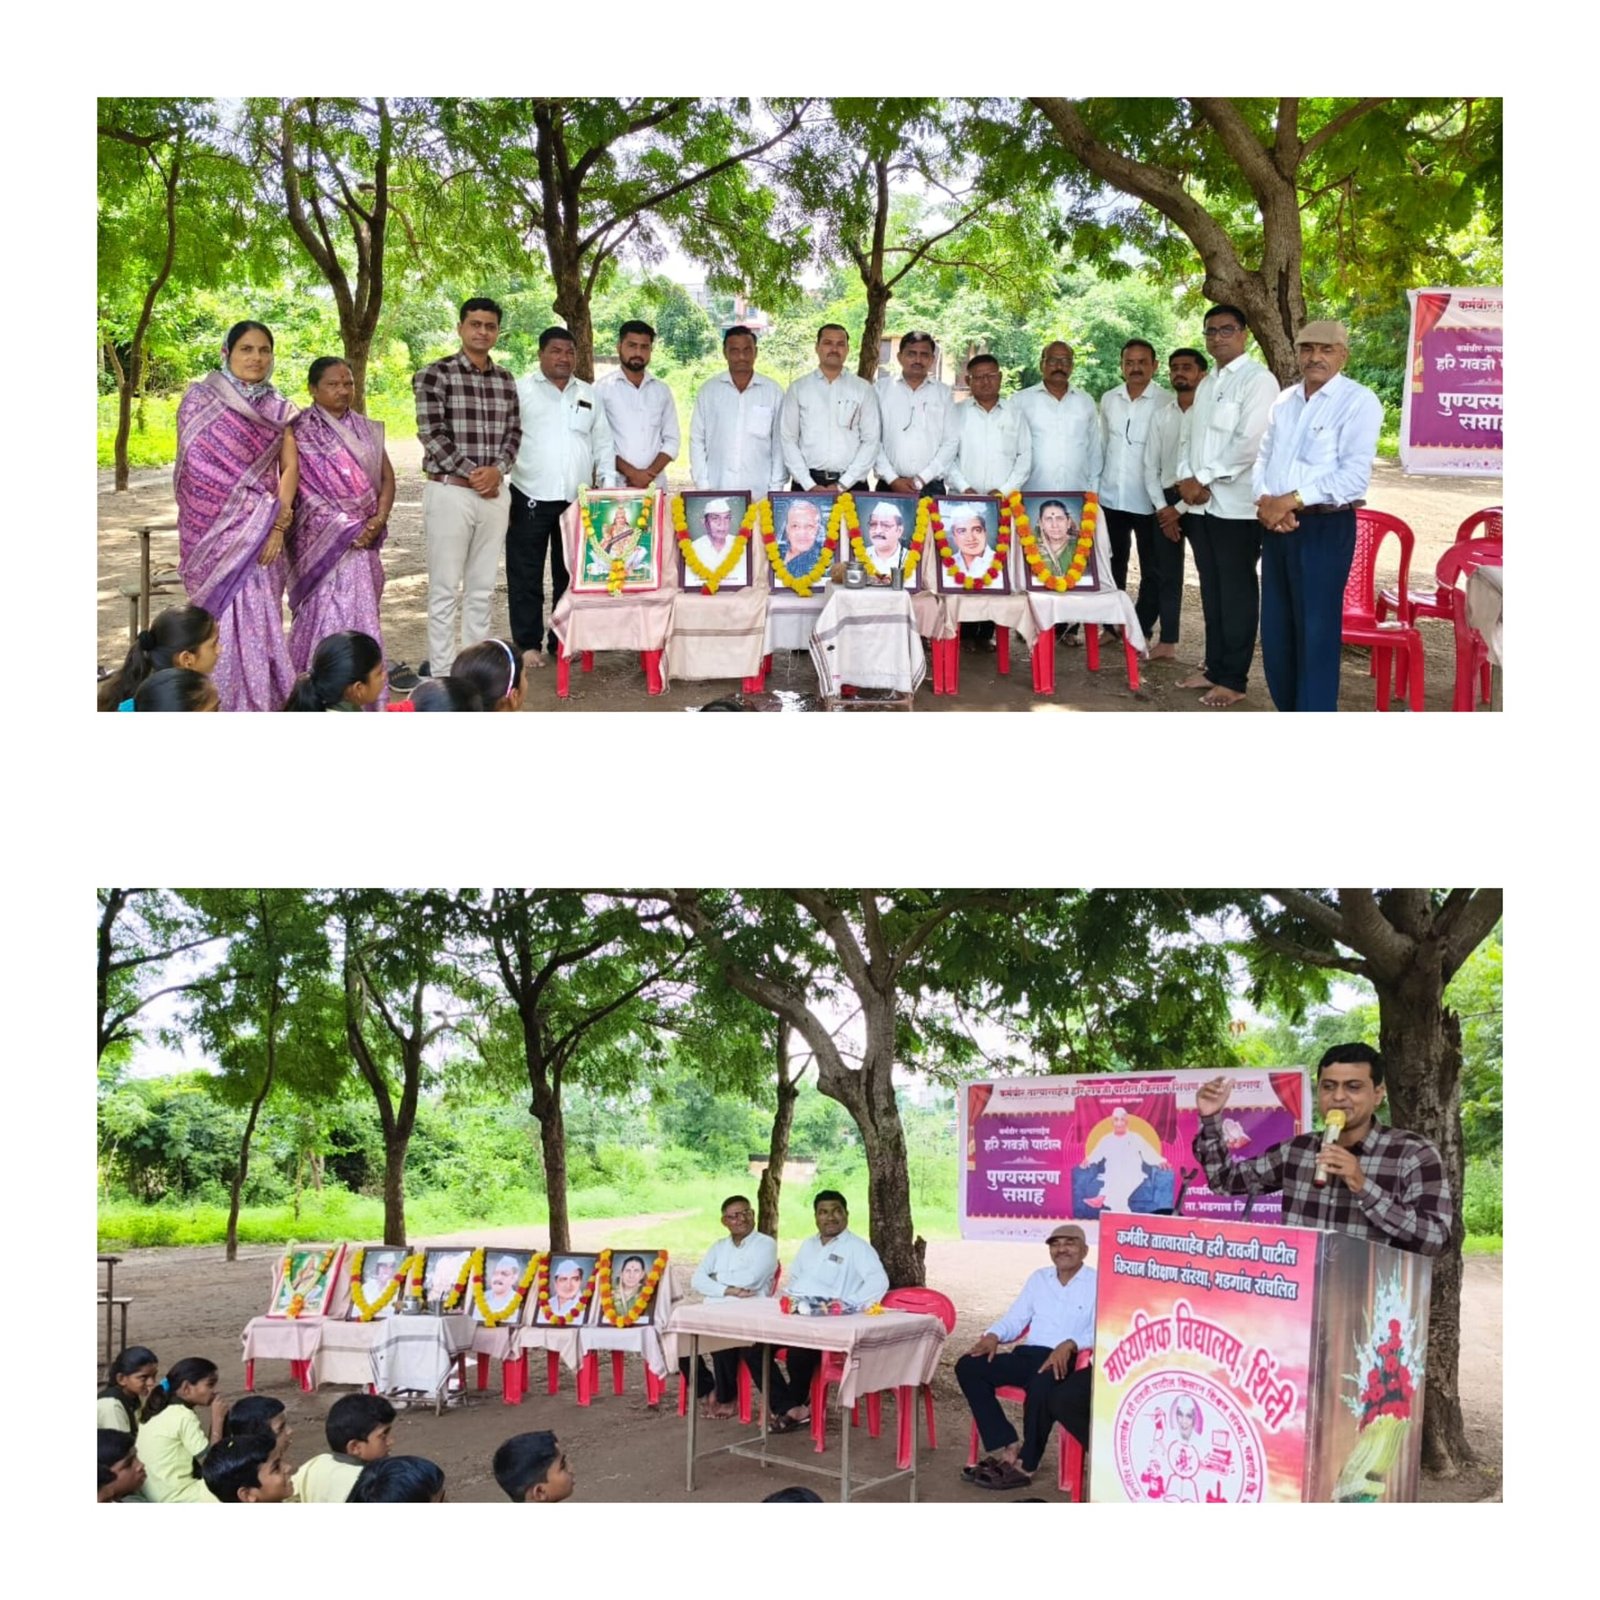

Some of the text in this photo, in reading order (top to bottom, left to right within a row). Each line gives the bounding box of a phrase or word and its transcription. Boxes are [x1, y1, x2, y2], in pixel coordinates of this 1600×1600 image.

[986, 1170, 1061, 1191] पुण्यस्मरण
[1002, 1188, 1045, 1206] सप्ताह
[1117, 1226, 1297, 1265] कर्मवीर तात्यासाहेब हरी रावजी पाटील
[1113, 1254, 1145, 1276] किसान
[1147, 1259, 1178, 1282] शिक्षण
[1215, 1269, 1252, 1293] भडगांव
[1254, 1272, 1297, 1299] संचलित
[1103, 1313, 1172, 1383] माध्यमिक
